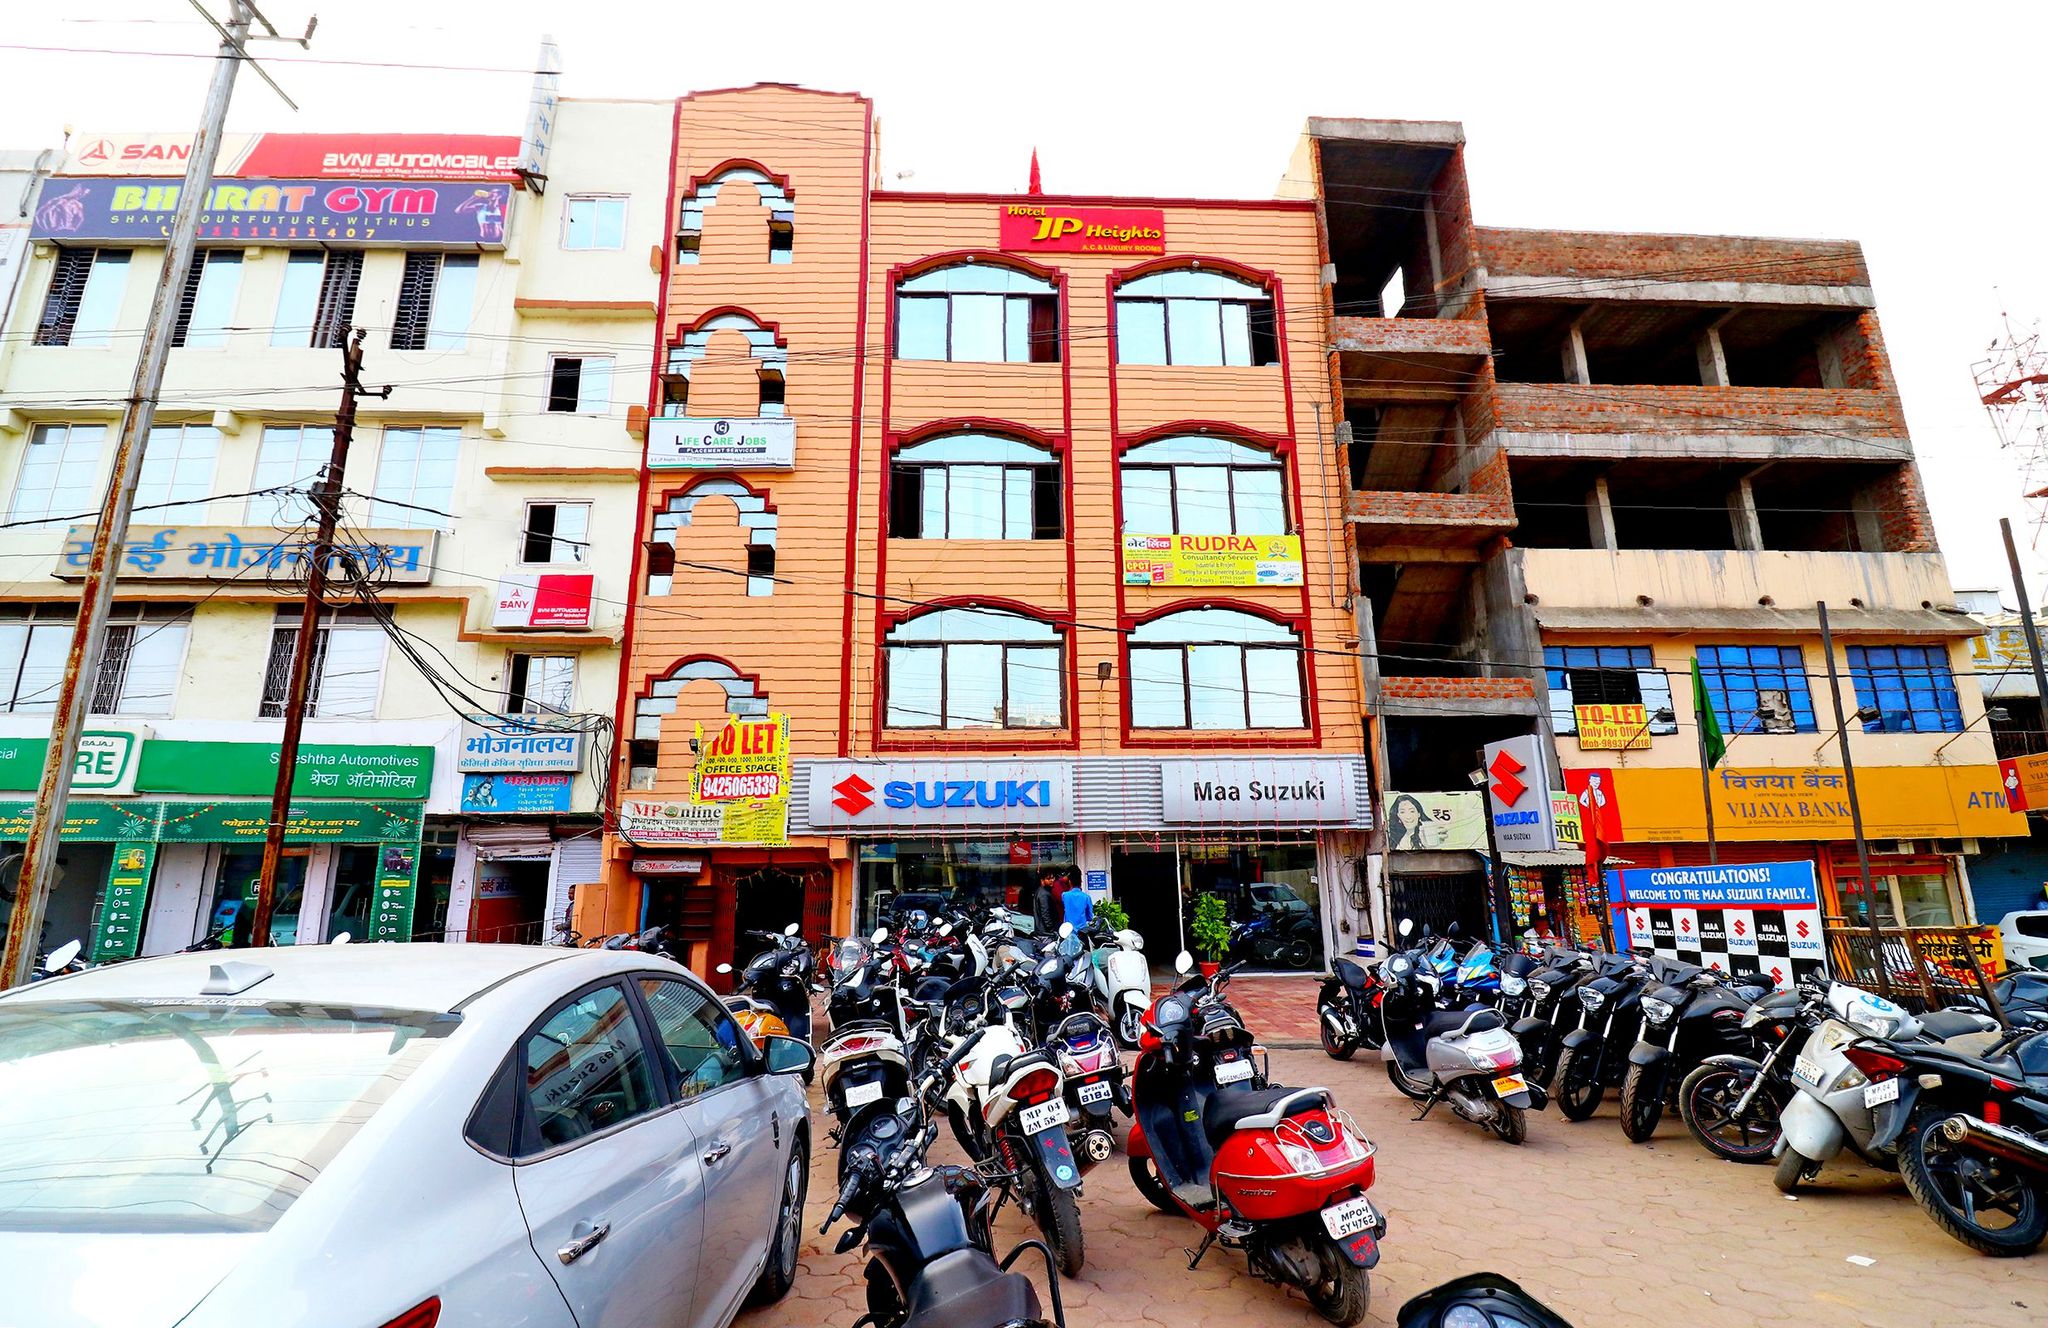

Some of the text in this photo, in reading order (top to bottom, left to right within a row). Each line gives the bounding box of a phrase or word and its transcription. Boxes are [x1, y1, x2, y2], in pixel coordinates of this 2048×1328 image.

[121, 145, 191, 160] SAN
[376, 154, 519, 169] AUTOMOBILES
[110, 185, 437, 214] BHRAT GYM
[1007, 206, 1046, 216] Hotel
[1031, 217, 1161, 242] JP Heights
[1180, 536, 1257, 551] RUDRA
[1182, 554, 1226, 562] Consultancy
[1209, 568, 1235, 576] Engineering
[500, 601, 529, 609] SANY
[1577, 705, 1643, 726] TO-LET
[1582, 726, 1648, 738] Only For Office
[466, 733, 575, 754] भोजनालय
[742, 724, 777, 755] LET
[74, 751, 115, 775] RE
[339, 753, 419, 767] Automotives
[705, 764, 777, 774] OFFICE SPACE
[309, 769, 417, 788] श्रेष्ठा ऑटोमोटिव्स
[1721, 768, 1844, 790] विजया बैंक
[703, 775, 777, 797] 9425065339
[1194, 780, 1325, 802] Maa Suzuki
[884, 780, 1050, 808] SUZUKI
[1968, 791, 2007, 809] ATM
[633, 803, 662, 817] MP
[1727, 801, 1852, 818] VIJAYA BANK
[1494, 810, 1539, 827] SUZUKI
[1503, 833, 1514, 841] MAA
[1650, 867, 1771, 886] CONGRATULATIONS!
[1628, 887, 1810, 901] WELCOME TO THE MAA SUZUKI FAMILY.
[1655, 920, 1669, 929] MAA
[1703, 922, 1719, 931] MAA
[1761, 923, 1780, 934] MAA
[1632, 932, 1652, 941] SUZUKI
[1653, 929, 1674, 937] SUZUKI
[1677, 935, 1699, 944] SUZUKI
[1700, 931, 1726, 940] SUZUKI
[1757, 933, 1786, 943] SUZUKI
[1728, 937, 1756, 947] SUZUKI
[1790, 940, 1821, 950] SUZUKI
[1081, 1090, 1110, 1103] 8184
[1026, 1101, 1061, 1121] MP 04
[1026, 1120, 1042, 1133] ZM
